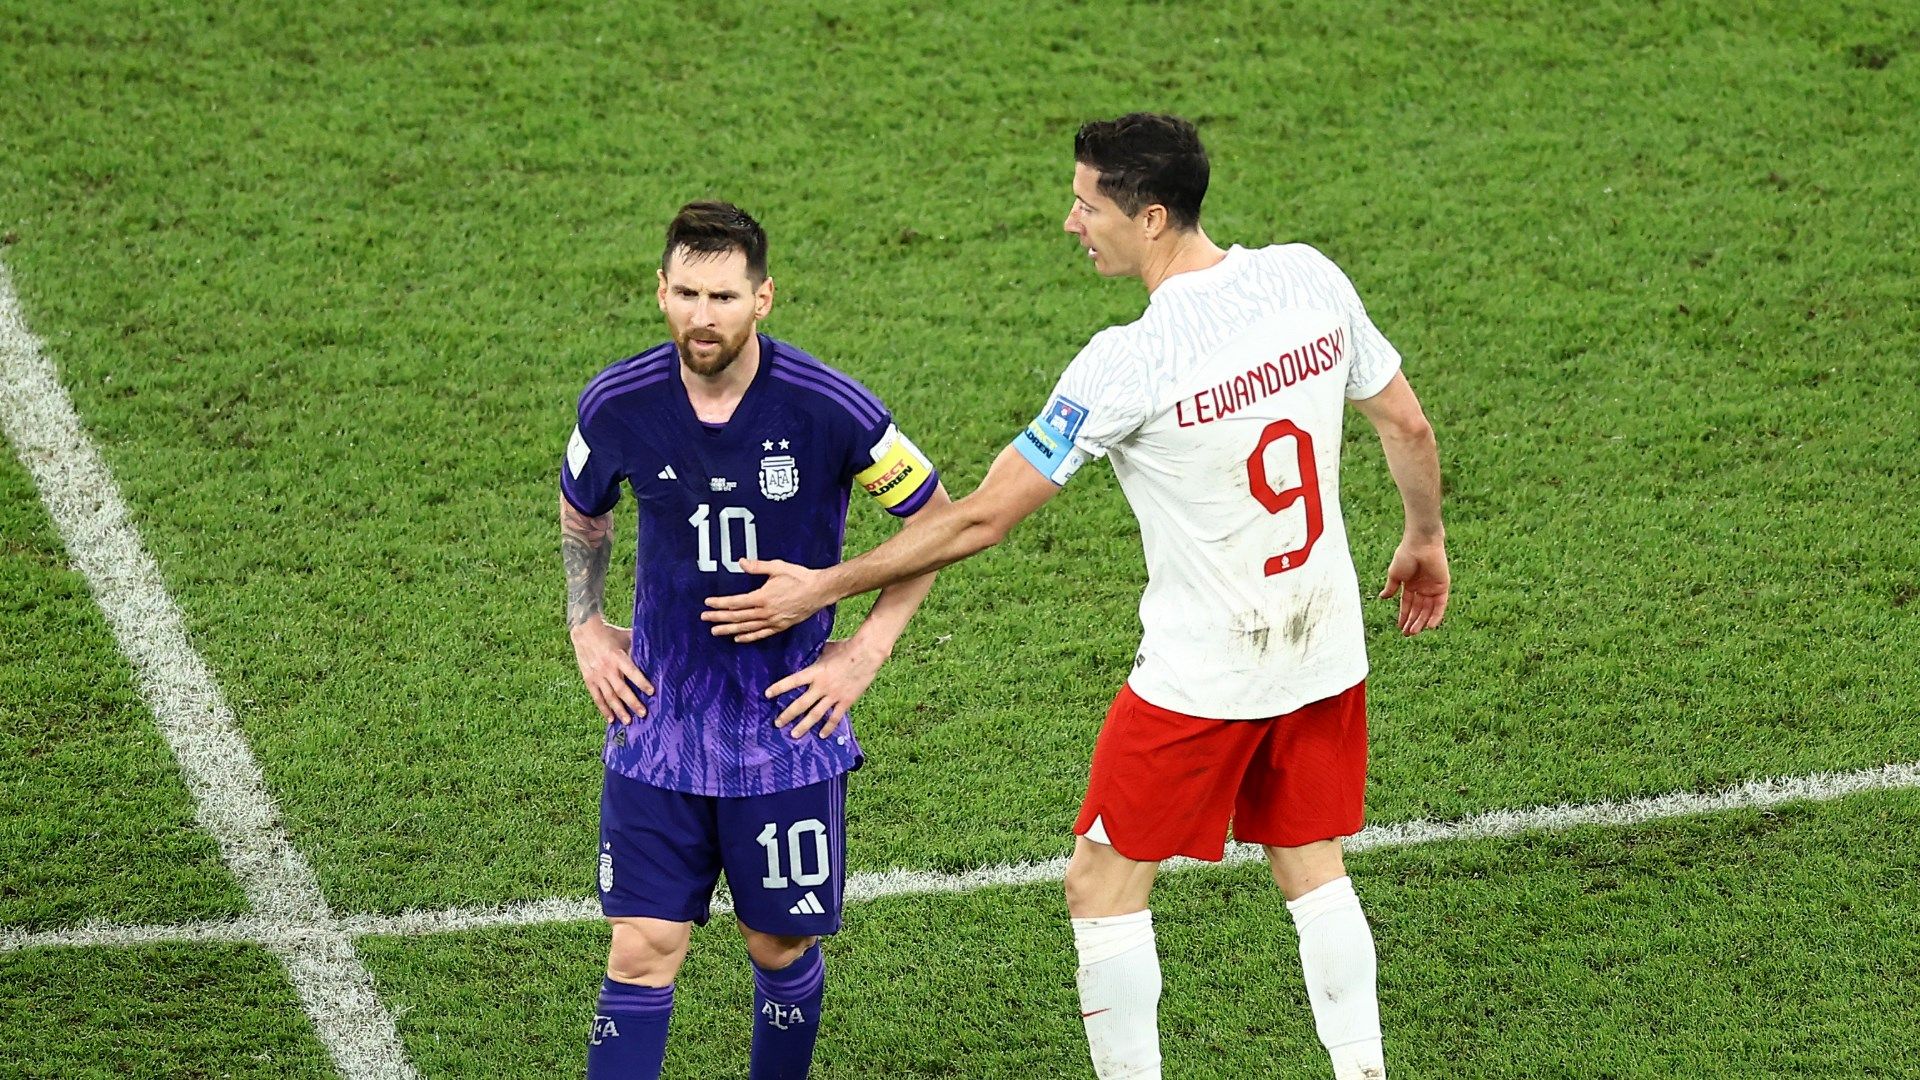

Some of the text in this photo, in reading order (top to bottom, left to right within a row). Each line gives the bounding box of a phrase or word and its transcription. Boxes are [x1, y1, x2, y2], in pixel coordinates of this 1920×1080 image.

[1176, 327, 1345, 428] LEWANDOWSKI
[688, 504, 758, 573] 10
[1247, 419, 1324, 577] 9
[756, 819, 830, 889] 10
